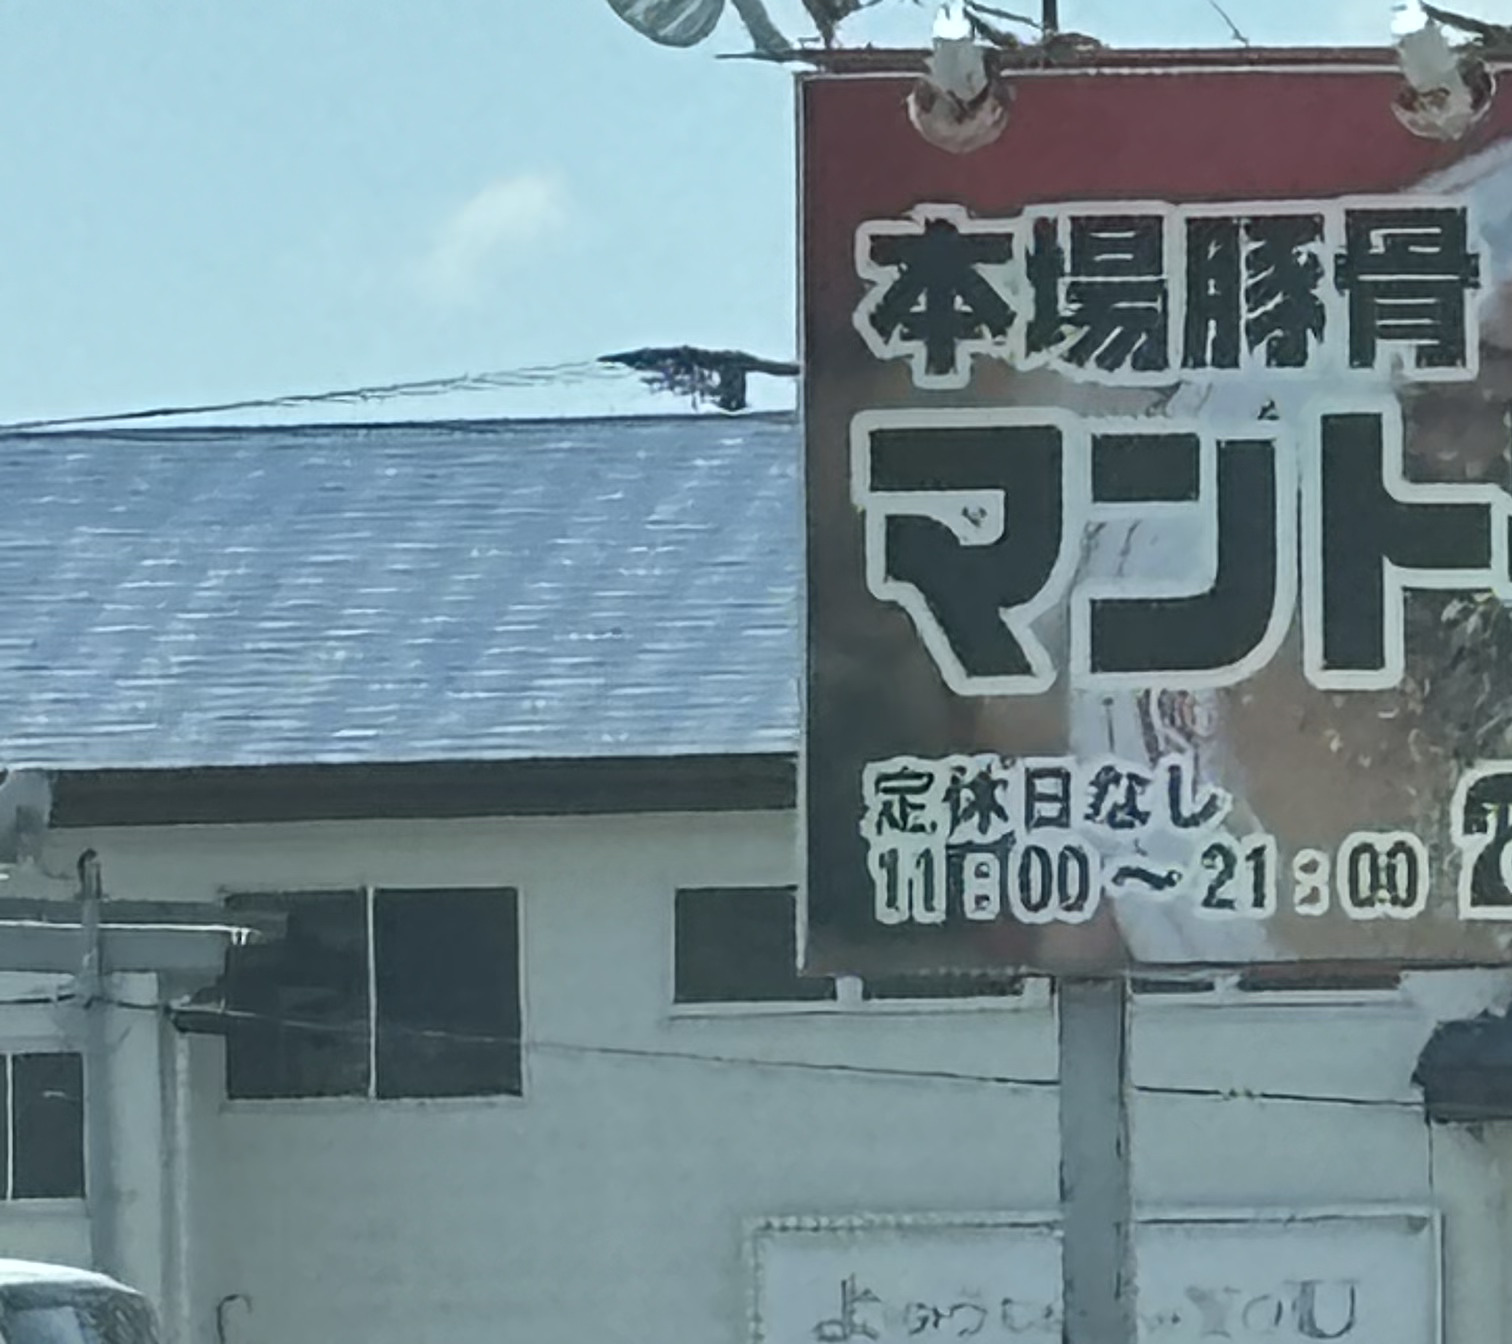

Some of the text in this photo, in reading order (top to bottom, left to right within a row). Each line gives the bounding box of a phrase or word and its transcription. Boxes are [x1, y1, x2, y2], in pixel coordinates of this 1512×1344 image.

[855, 196, 1482, 384] 本場豚骨
[866, 760, 1232, 840] 定休日なし
